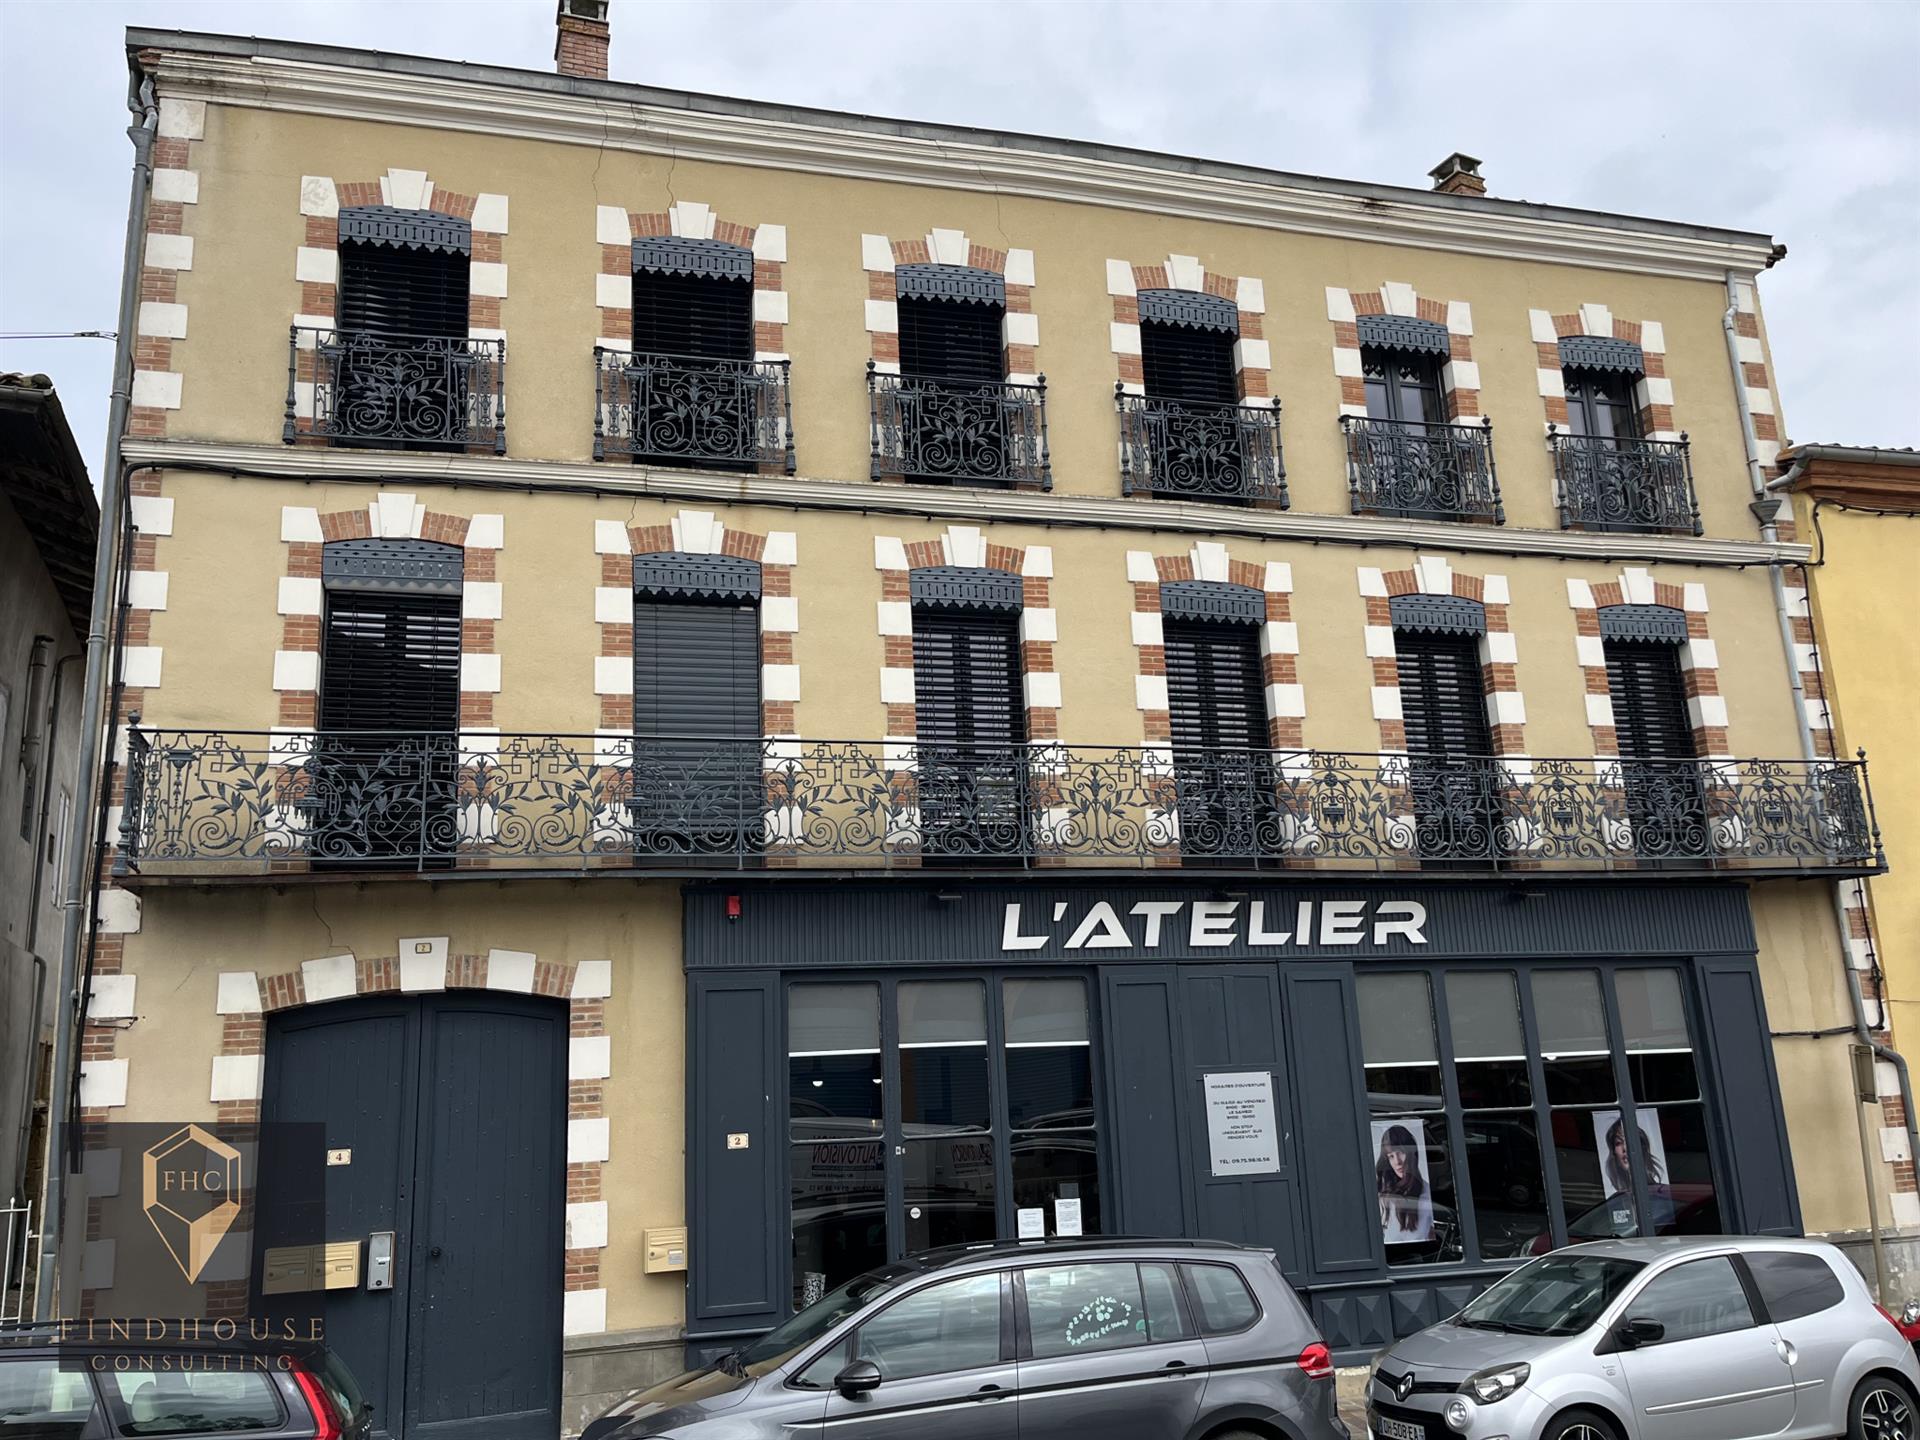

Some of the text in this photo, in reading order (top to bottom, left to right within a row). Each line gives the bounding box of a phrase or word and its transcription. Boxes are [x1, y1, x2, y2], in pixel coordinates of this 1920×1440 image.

[1002, 900, 1428, 951] L'ATELIER
[734, 1136, 741, 1145] 2
[335, 1152, 343, 1161] 4
